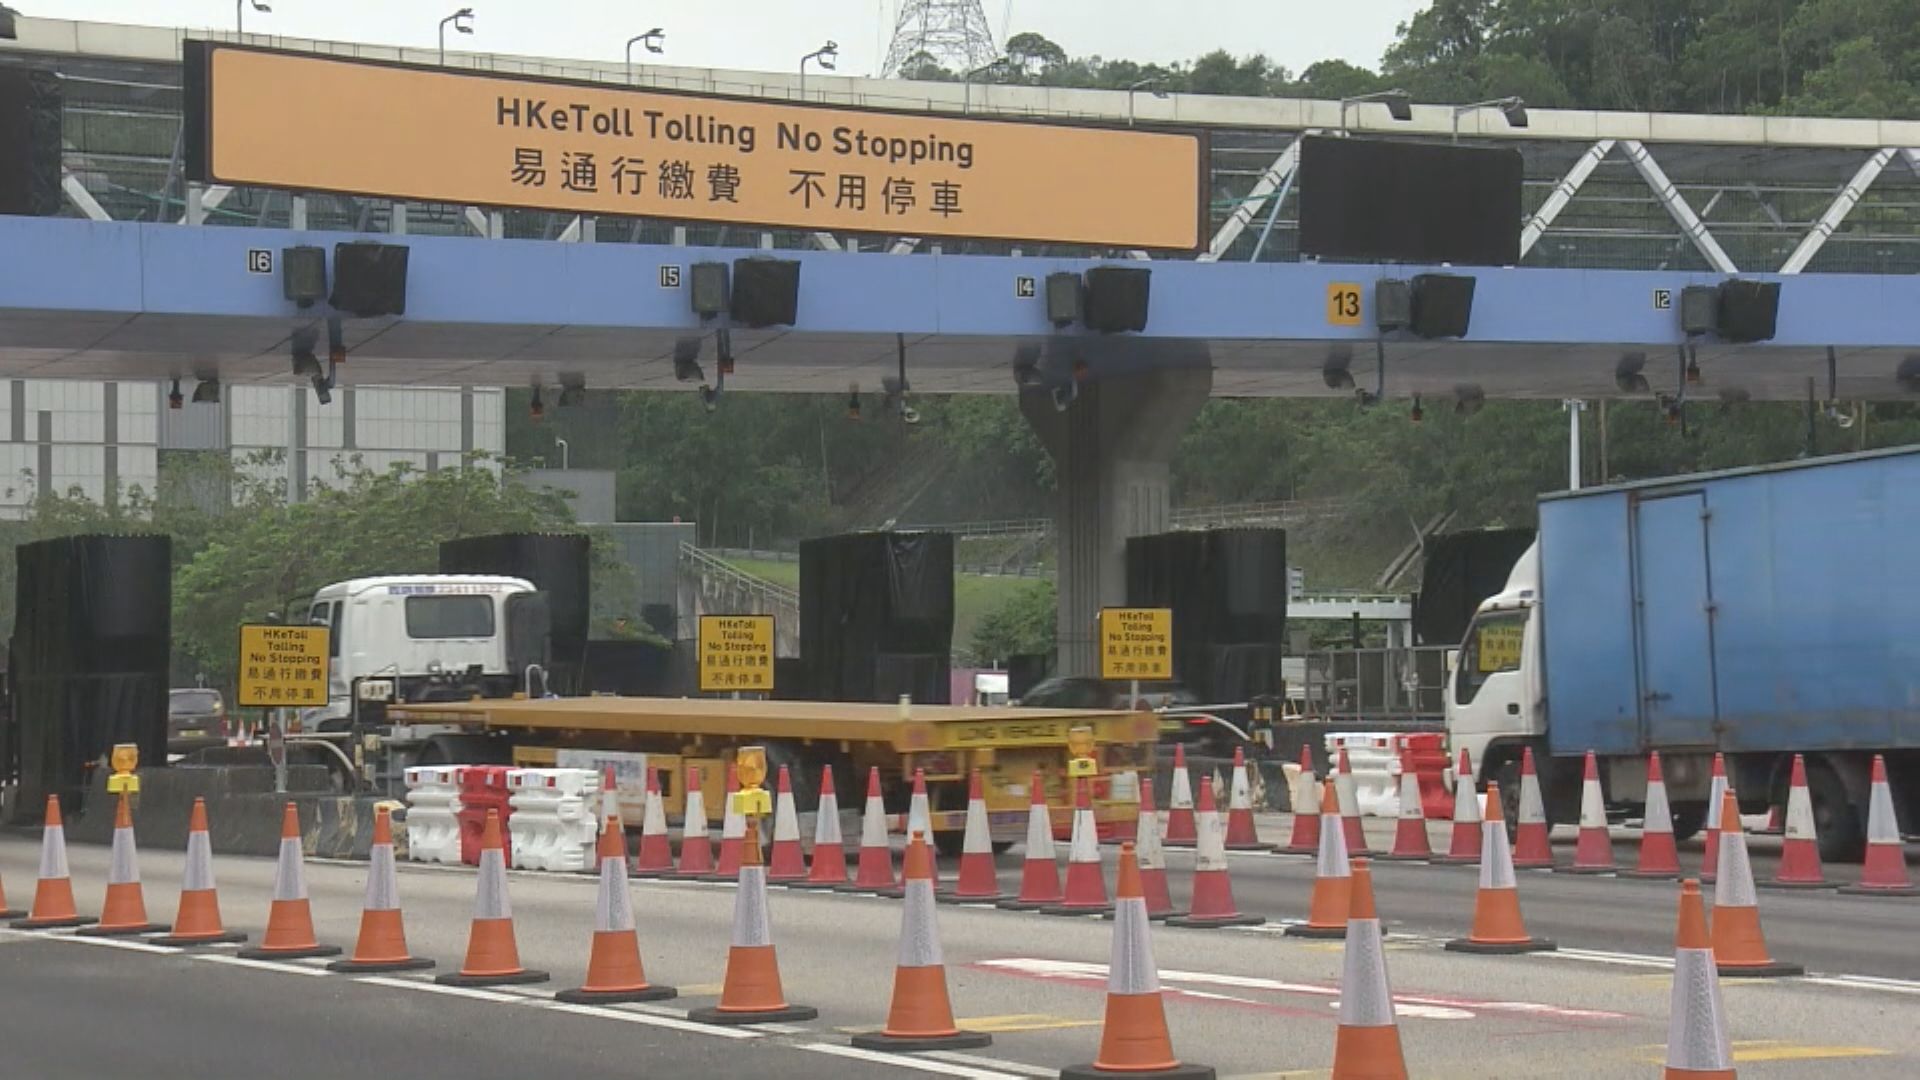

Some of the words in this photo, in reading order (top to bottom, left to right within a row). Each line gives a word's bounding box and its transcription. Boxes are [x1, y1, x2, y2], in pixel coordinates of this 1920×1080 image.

[497, 97, 634, 137] HKeToll
[643, 110, 755, 153] Tolling
[777, 122, 822, 152] No
[833, 126, 973, 169] Stopping
[511, 147, 742, 204] 易通行繳費
[789, 169, 964, 219] 不用停車
[250, 251, 271, 271] 16
[663, 267, 679, 286] 15
[1018, 278, 1034, 296] 14
[1333, 291, 1360, 317] 13
[1656, 290, 1671, 308] 12
[250, 652, 266, 663] No
